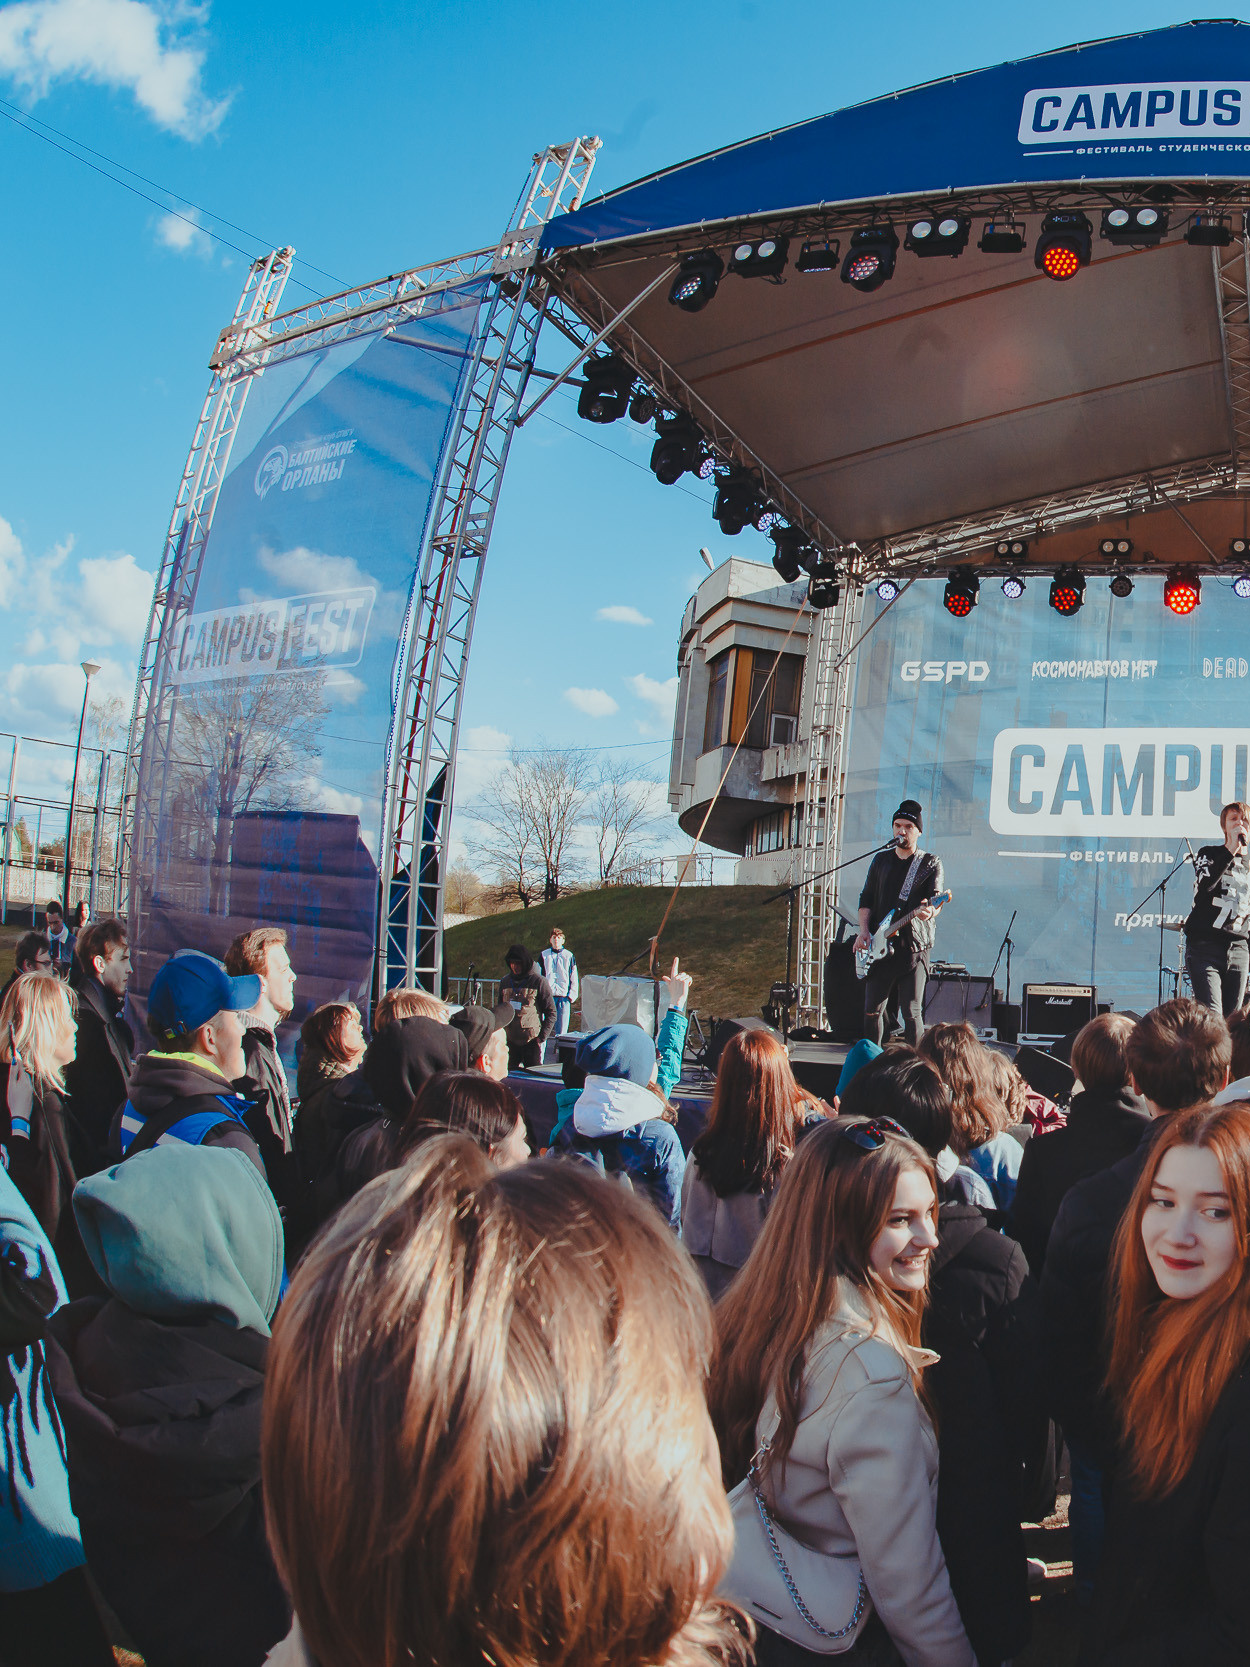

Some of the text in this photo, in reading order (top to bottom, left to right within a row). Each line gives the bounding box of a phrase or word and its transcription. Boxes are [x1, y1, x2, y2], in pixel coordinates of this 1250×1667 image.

[1031, 89, 1242, 133] CAMPUS
[1076, 145, 1153, 155] ФЕСТИВАЛЬ
[288, 439, 358, 468] БАЛТИЙСКИЕ
[281, 458, 346, 492] ОРЛАНЫ
[177, 597, 366, 672] CAMPUS FEST
[900, 661, 991, 684] GSPD
[1031, 660, 1158, 681] КОСМОНАВТОВ НЕТ
[1203, 657, 1249, 679] DEAD
[1069, 850, 1175, 865] ФЕСТИВАЛЬ
[1045, 996, 1073, 1006] Marshall
